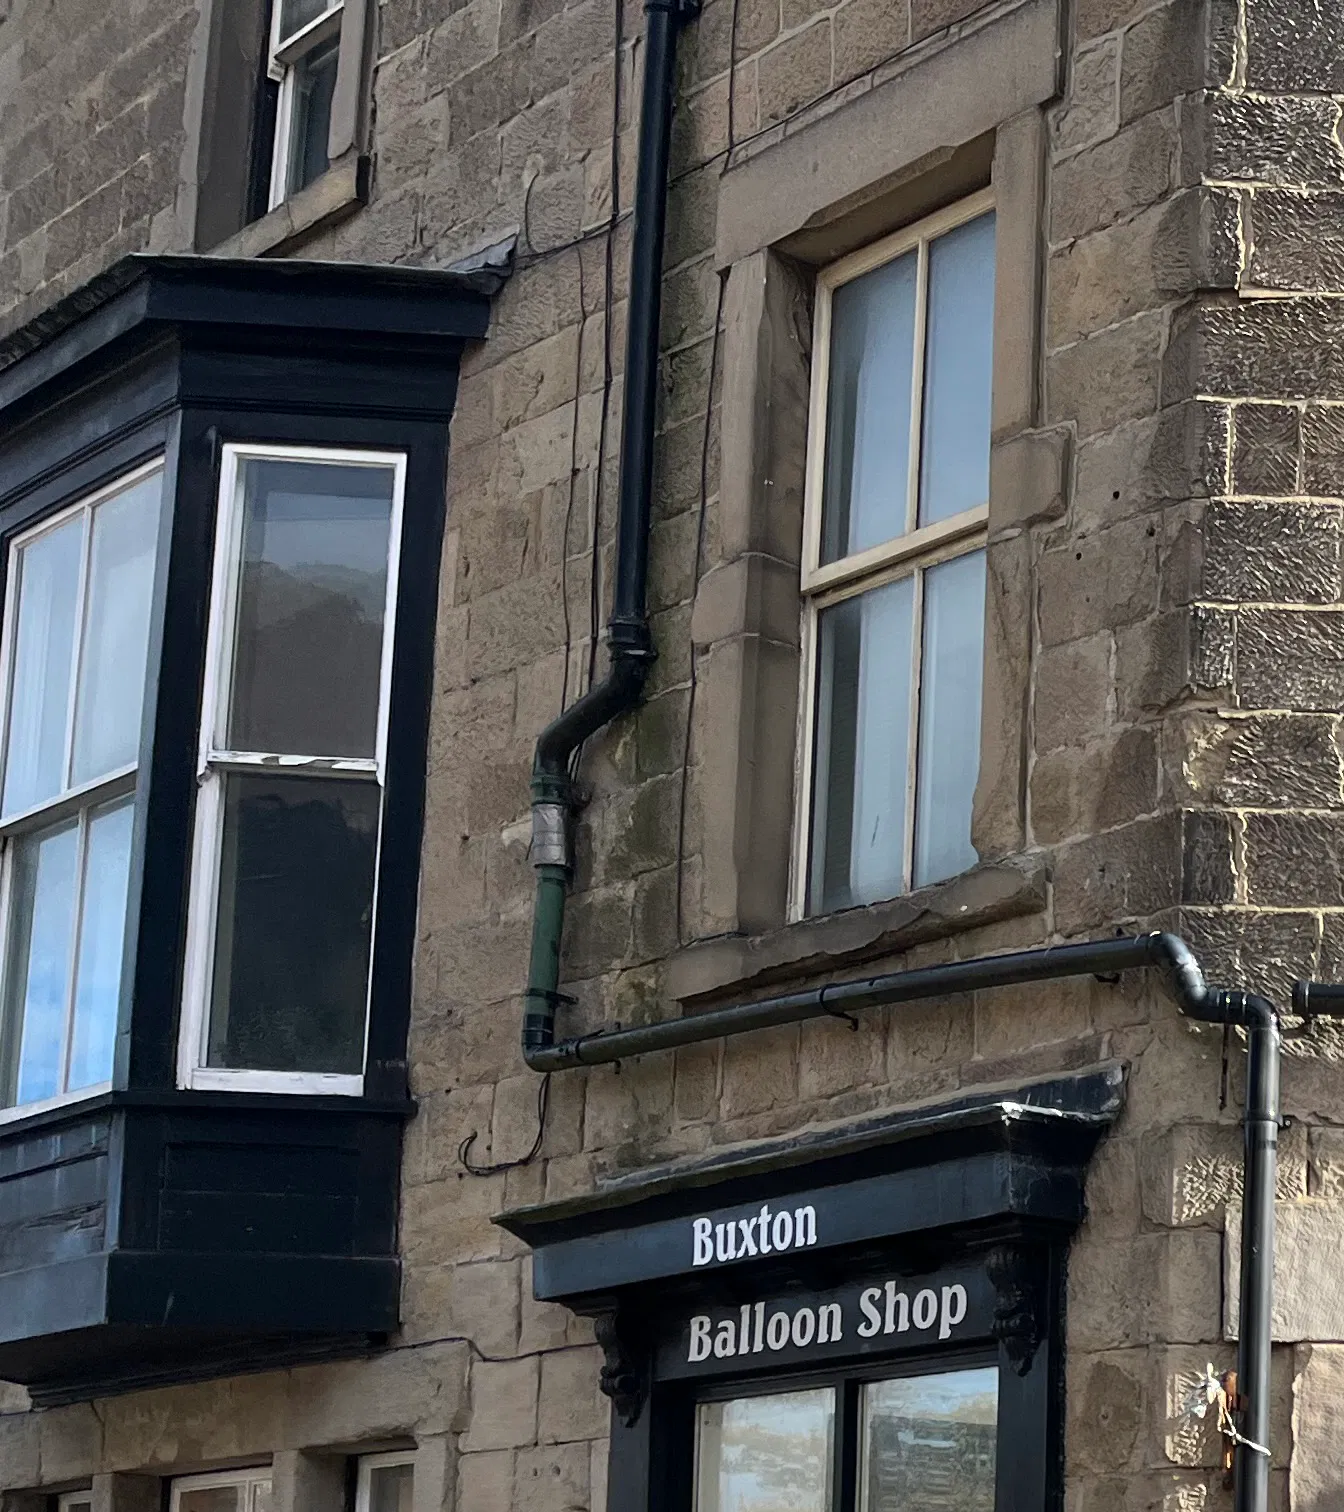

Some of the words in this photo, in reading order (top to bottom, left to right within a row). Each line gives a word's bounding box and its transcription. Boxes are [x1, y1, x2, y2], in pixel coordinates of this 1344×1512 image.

[692, 1203, 818, 1266] Buxton
[687, 1302, 842, 1362] Balloon
[856, 1280, 968, 1339] Shop
